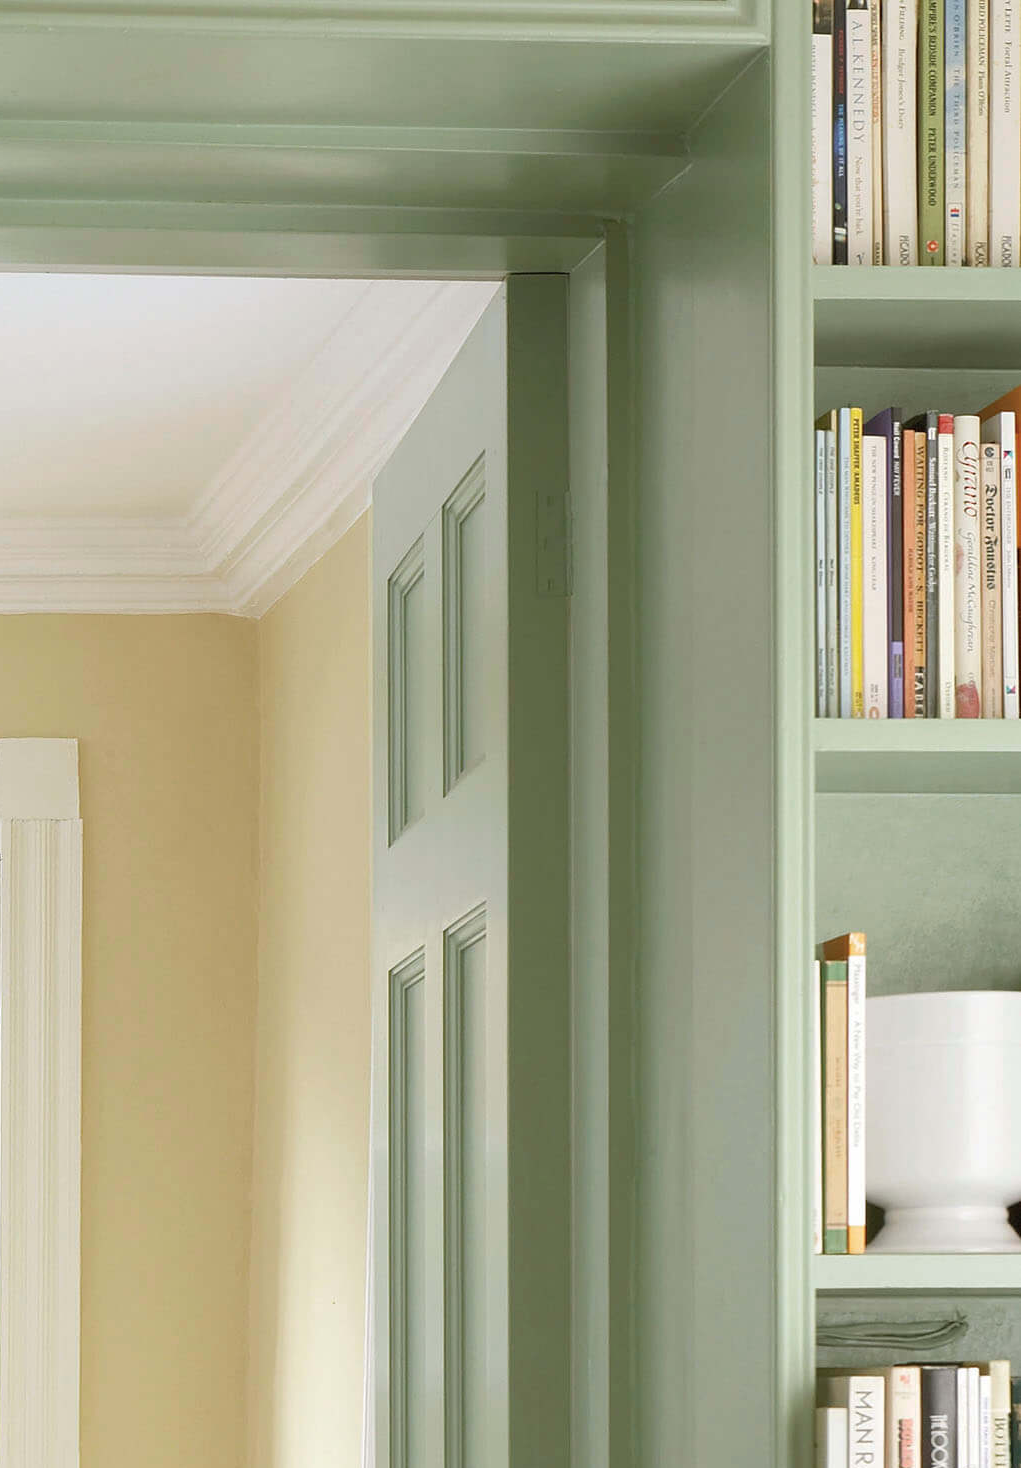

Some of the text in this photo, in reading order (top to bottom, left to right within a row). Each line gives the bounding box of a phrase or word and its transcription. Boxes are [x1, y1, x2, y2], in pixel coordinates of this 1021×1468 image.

[916, 446, 925, 498] WAITING
[956, 441, 979, 521] Cyrano
[855, 1390, 874, 1443] MAN
